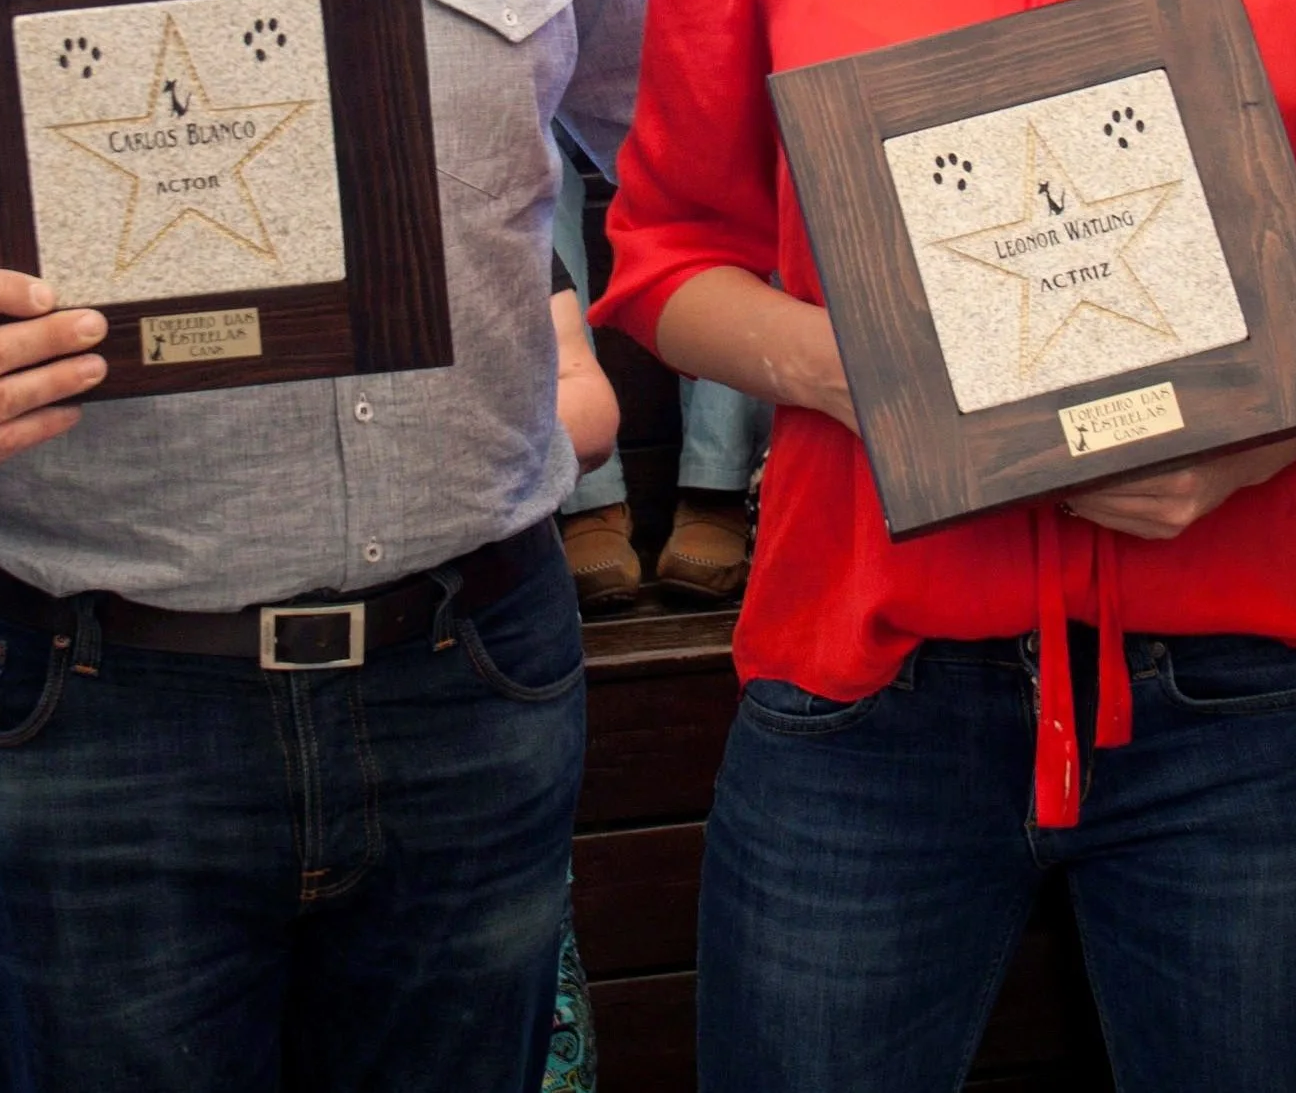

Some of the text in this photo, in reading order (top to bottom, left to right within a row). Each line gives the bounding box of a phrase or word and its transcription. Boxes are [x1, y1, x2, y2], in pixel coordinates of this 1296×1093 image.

[157, 175, 220, 195] ACTOR
[994, 210, 1134, 259] LEONOR WATLING
[1040, 262, 1112, 293] ACTRIZ
[1067, 386, 1170, 423] TORREIRO DAS
[1090, 404, 1167, 433] ESTRELAS
[1112, 426, 1148, 441] CANS
